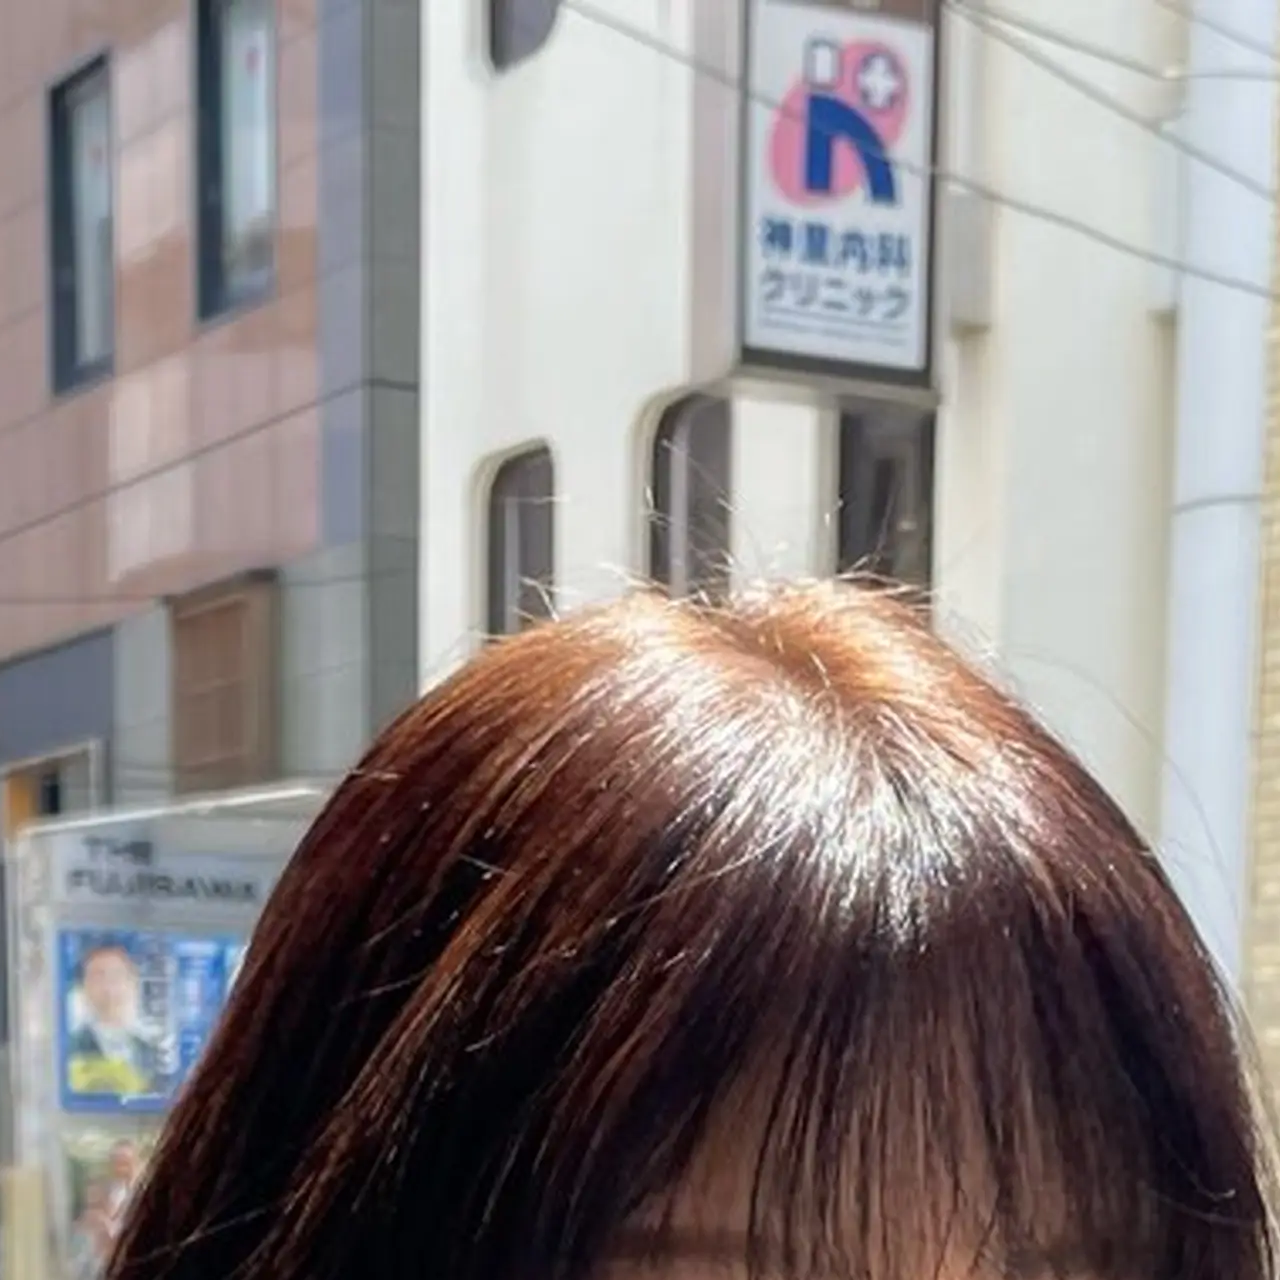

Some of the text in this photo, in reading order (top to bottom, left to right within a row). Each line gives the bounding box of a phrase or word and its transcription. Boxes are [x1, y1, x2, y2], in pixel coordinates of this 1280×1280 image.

[760, 268, 912, 321] クリニック
